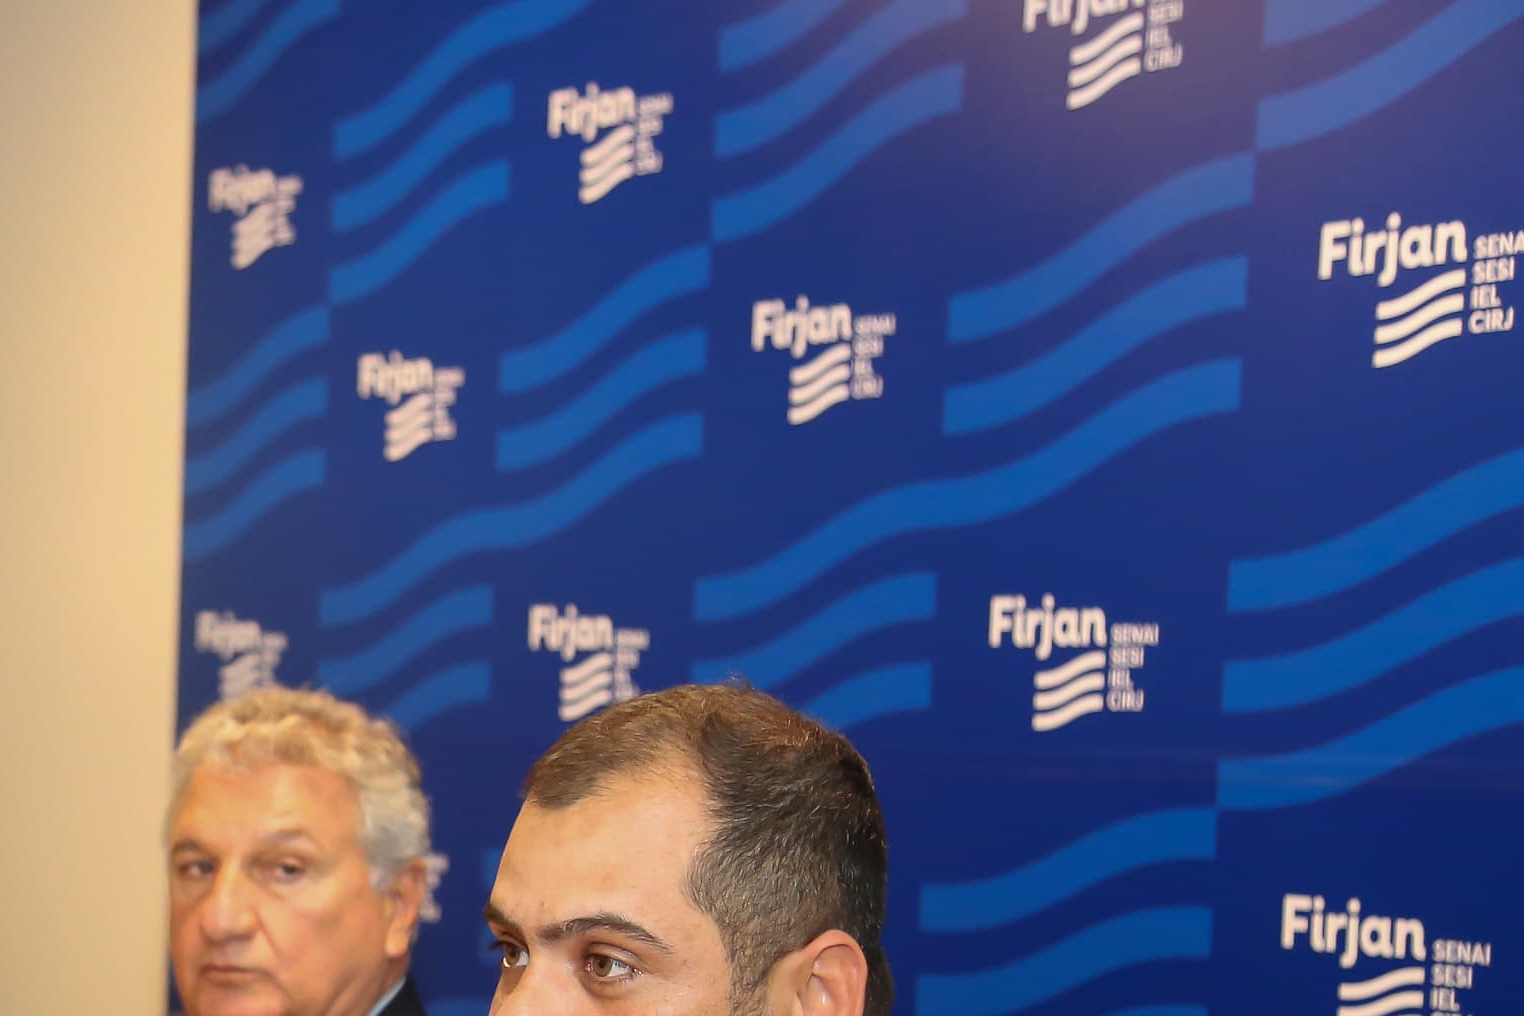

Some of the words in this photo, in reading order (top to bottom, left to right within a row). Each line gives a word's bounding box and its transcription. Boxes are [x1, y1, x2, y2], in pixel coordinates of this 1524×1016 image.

[1021, 0, 1145, 35] Firj
[547, 80, 636, 143] Firjan
[1318, 211, 1467, 287] Firjan
[1472, 256, 1515, 285] SESI
[1470, 282, 1501, 310] IEL
[751, 294, 852, 359] Firjan
[1467, 304, 1514, 334] CIRJ
[527, 602, 614, 662] Firjan
[988, 592, 1107, 661] Firjan
[1281, 893, 1427, 969] Firjan
[1432, 938, 1492, 967] SENAI
[1431, 963, 1473, 989] SESI
[1430, 987, 1461, 1012] IEL
